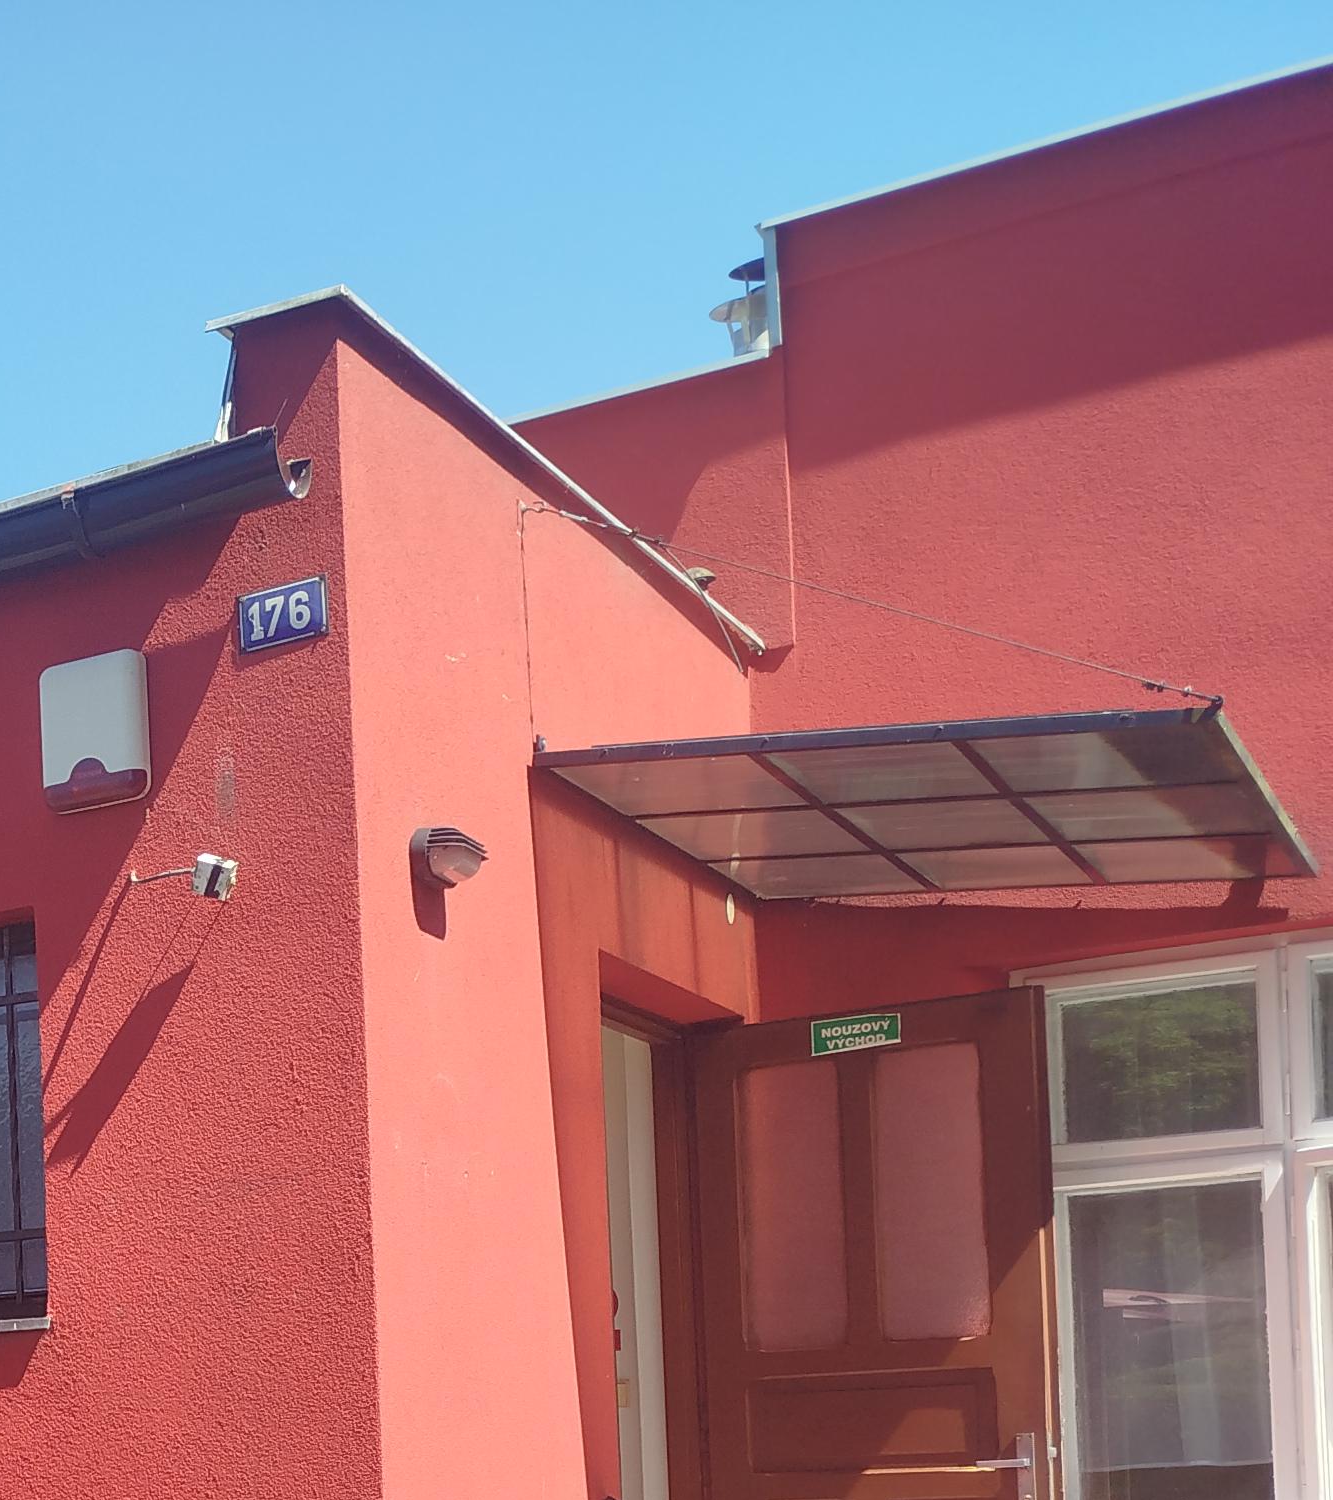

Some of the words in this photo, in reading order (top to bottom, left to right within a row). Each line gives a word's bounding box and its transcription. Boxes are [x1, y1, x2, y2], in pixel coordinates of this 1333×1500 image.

[247, 590, 311, 642] 176
[820, 1017, 891, 1039] NOUZOVÝ
[825, 1033, 887, 1050] VÝCHOD
